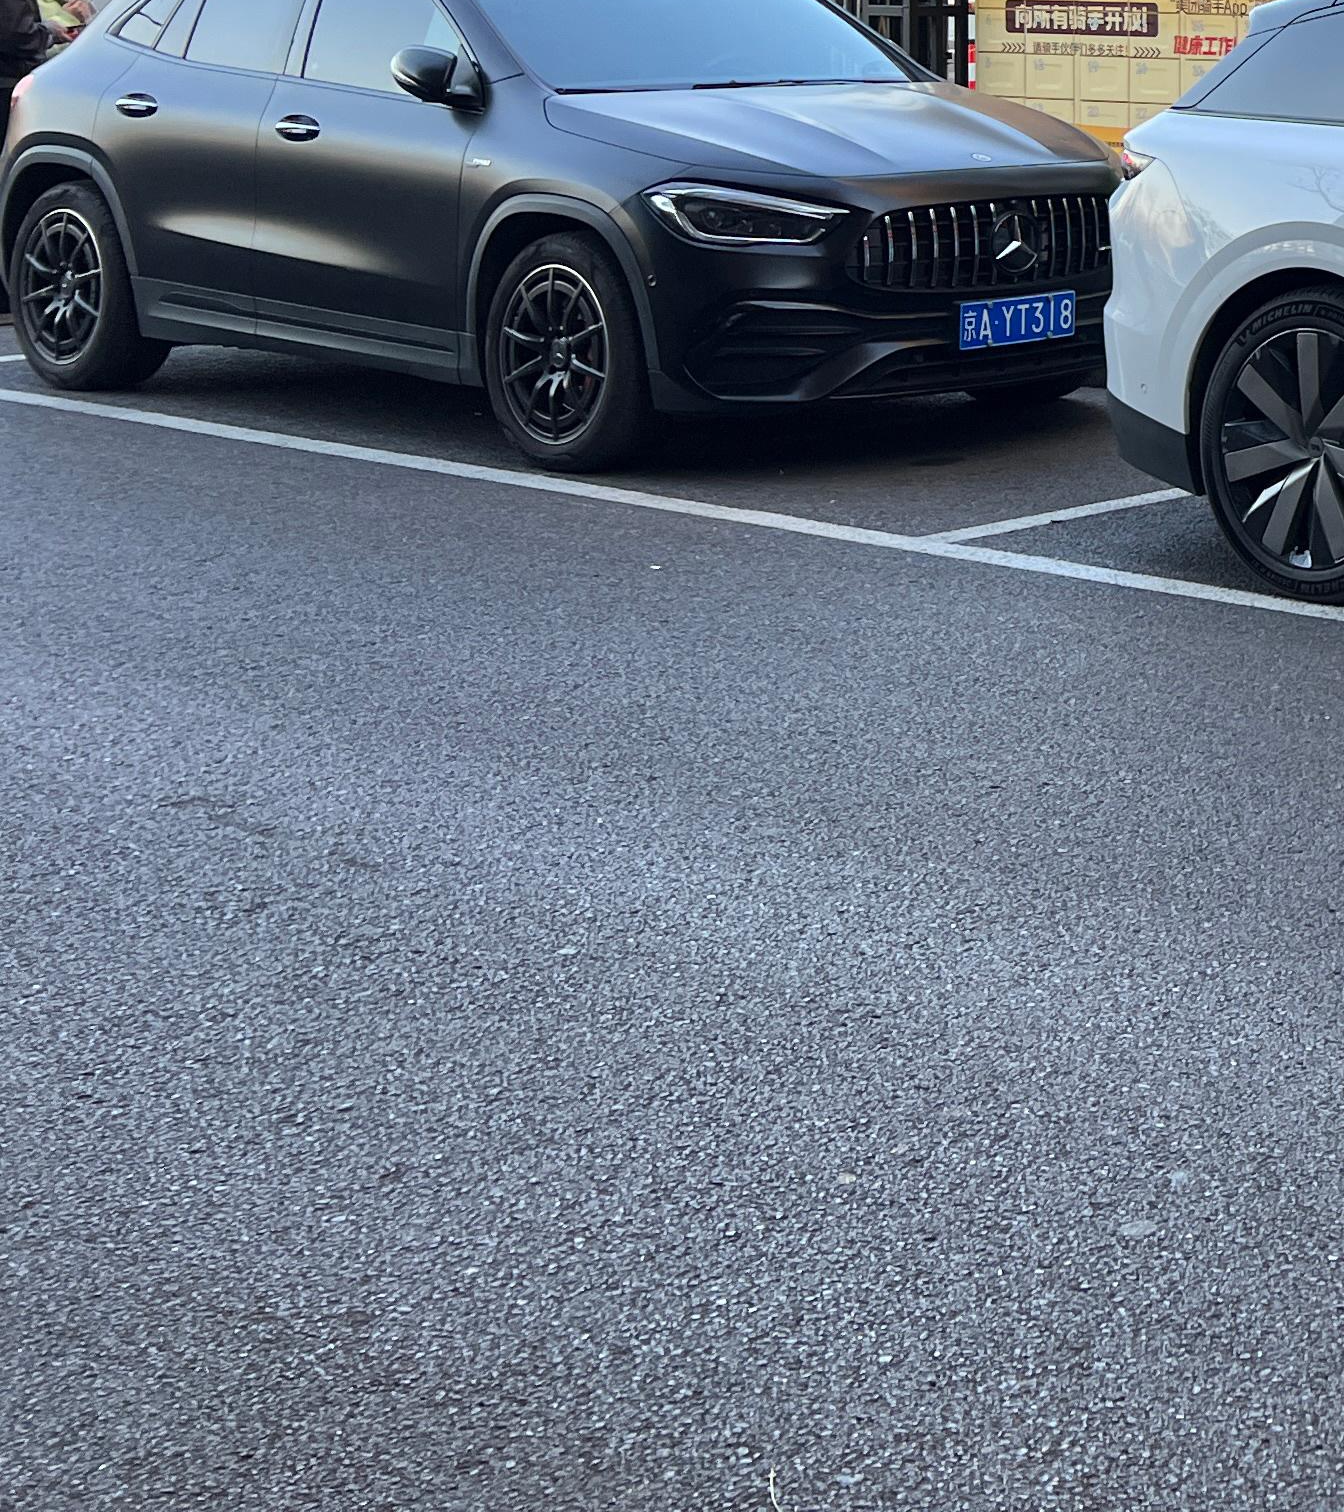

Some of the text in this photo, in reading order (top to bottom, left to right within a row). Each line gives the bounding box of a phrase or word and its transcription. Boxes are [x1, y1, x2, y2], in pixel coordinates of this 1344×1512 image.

[1015, 4, 1148, 33] 向所有骑手开放!
[963, 298, 1073, 342] 京A·YT318
[1250, 302, 1313, 335] MICHELIN
